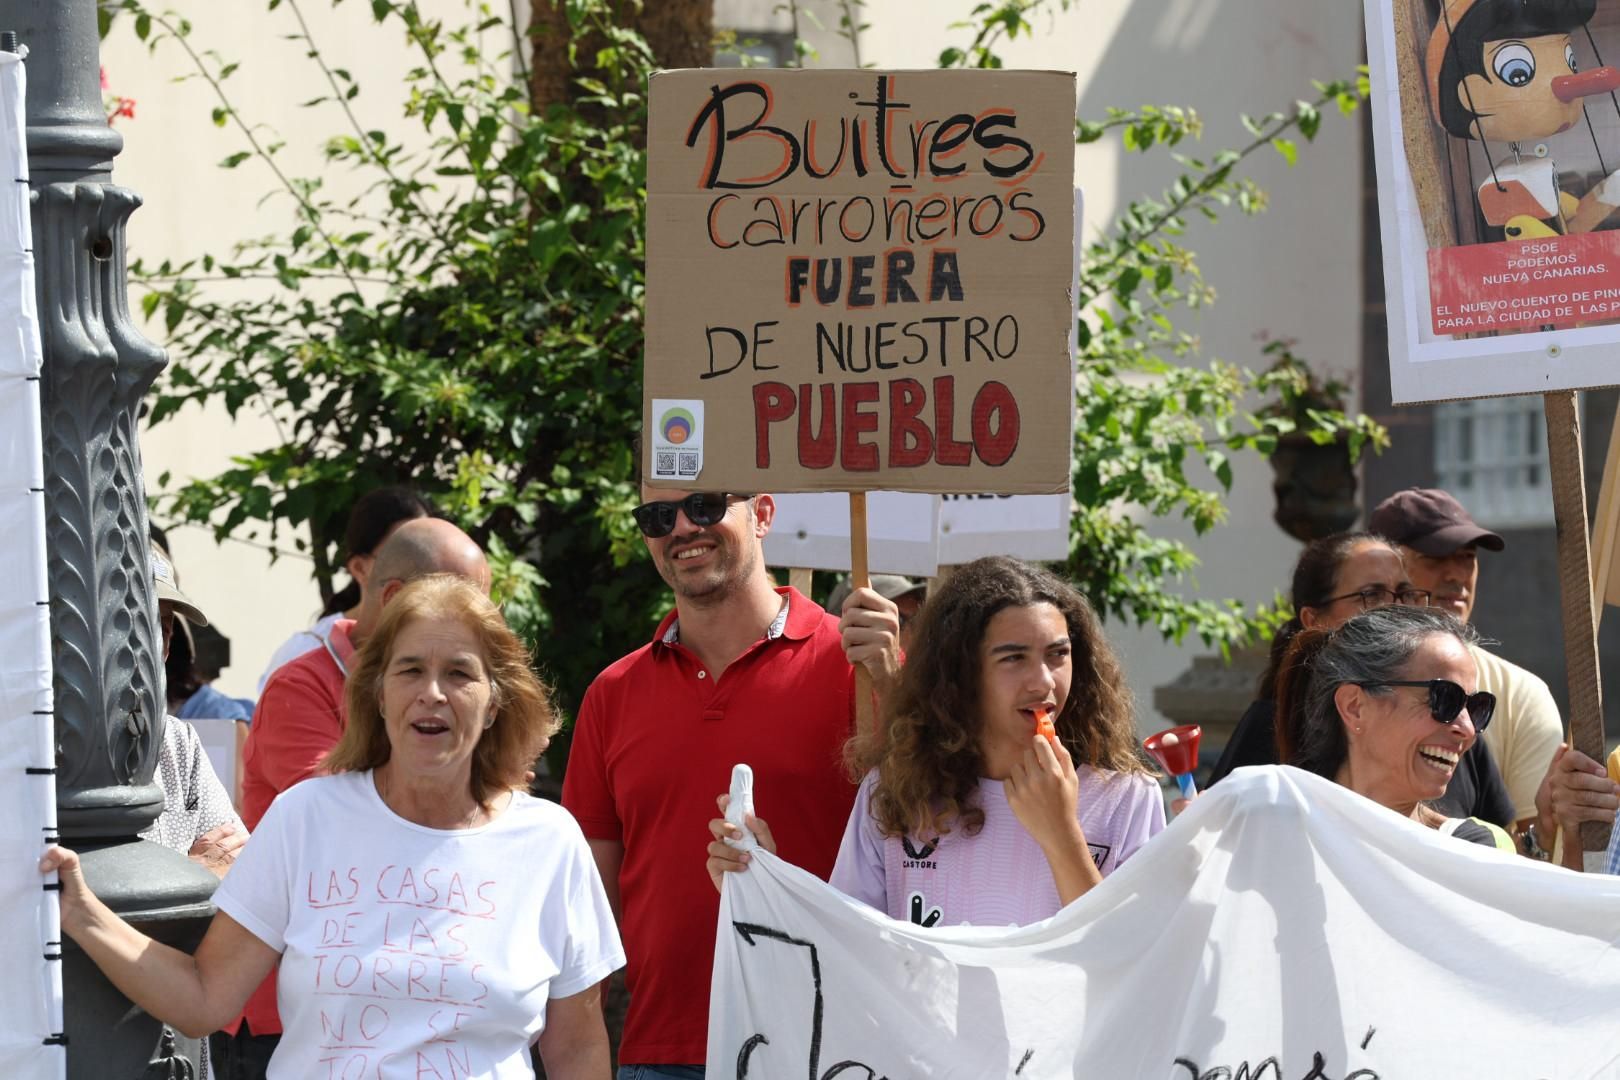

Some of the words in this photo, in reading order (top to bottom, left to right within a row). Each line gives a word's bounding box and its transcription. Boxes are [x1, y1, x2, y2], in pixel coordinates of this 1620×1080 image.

[686, 75, 1043, 189] Buitres
[707, 185, 1045, 248] carroñeros
[1508, 253, 1577, 269] PODEMOS
[1521, 242, 1558, 255] PSOE
[784, 247, 964, 309] FUERA
[1483, 271, 1529, 285] NUEVA
[1533, 263, 1609, 280] CANARIAS.
[1436, 305, 1453, 316] EL
[1460, 300, 1508, 313] NUEVO
[1511, 293, 1568, 308] CUENTO
[1572, 291, 1591, 302] DE
[1594, 288, 1620, 300] PIN
[1438, 316, 1474, 329] PARA
[1478, 314, 1496, 324] LA
[1499, 308, 1551, 322] CIUDAD
[1555, 306, 1573, 317] DE
[1580, 302, 1608, 314] LAS
[701, 321, 779, 379] DE
[816, 314, 1019, 374] NUESTRO
[752, 375, 1020, 472] PUEBLO
[902, 860, 937, 870] CASTORE
[308, 867, 359, 904] LAS
[376, 865, 496, 916] CASAS
[321, 912, 363, 945] DE
[383, 912, 469, 956] LAS
[313, 954, 489, 1002] TORRES
[320, 1004, 390, 1042] NO
